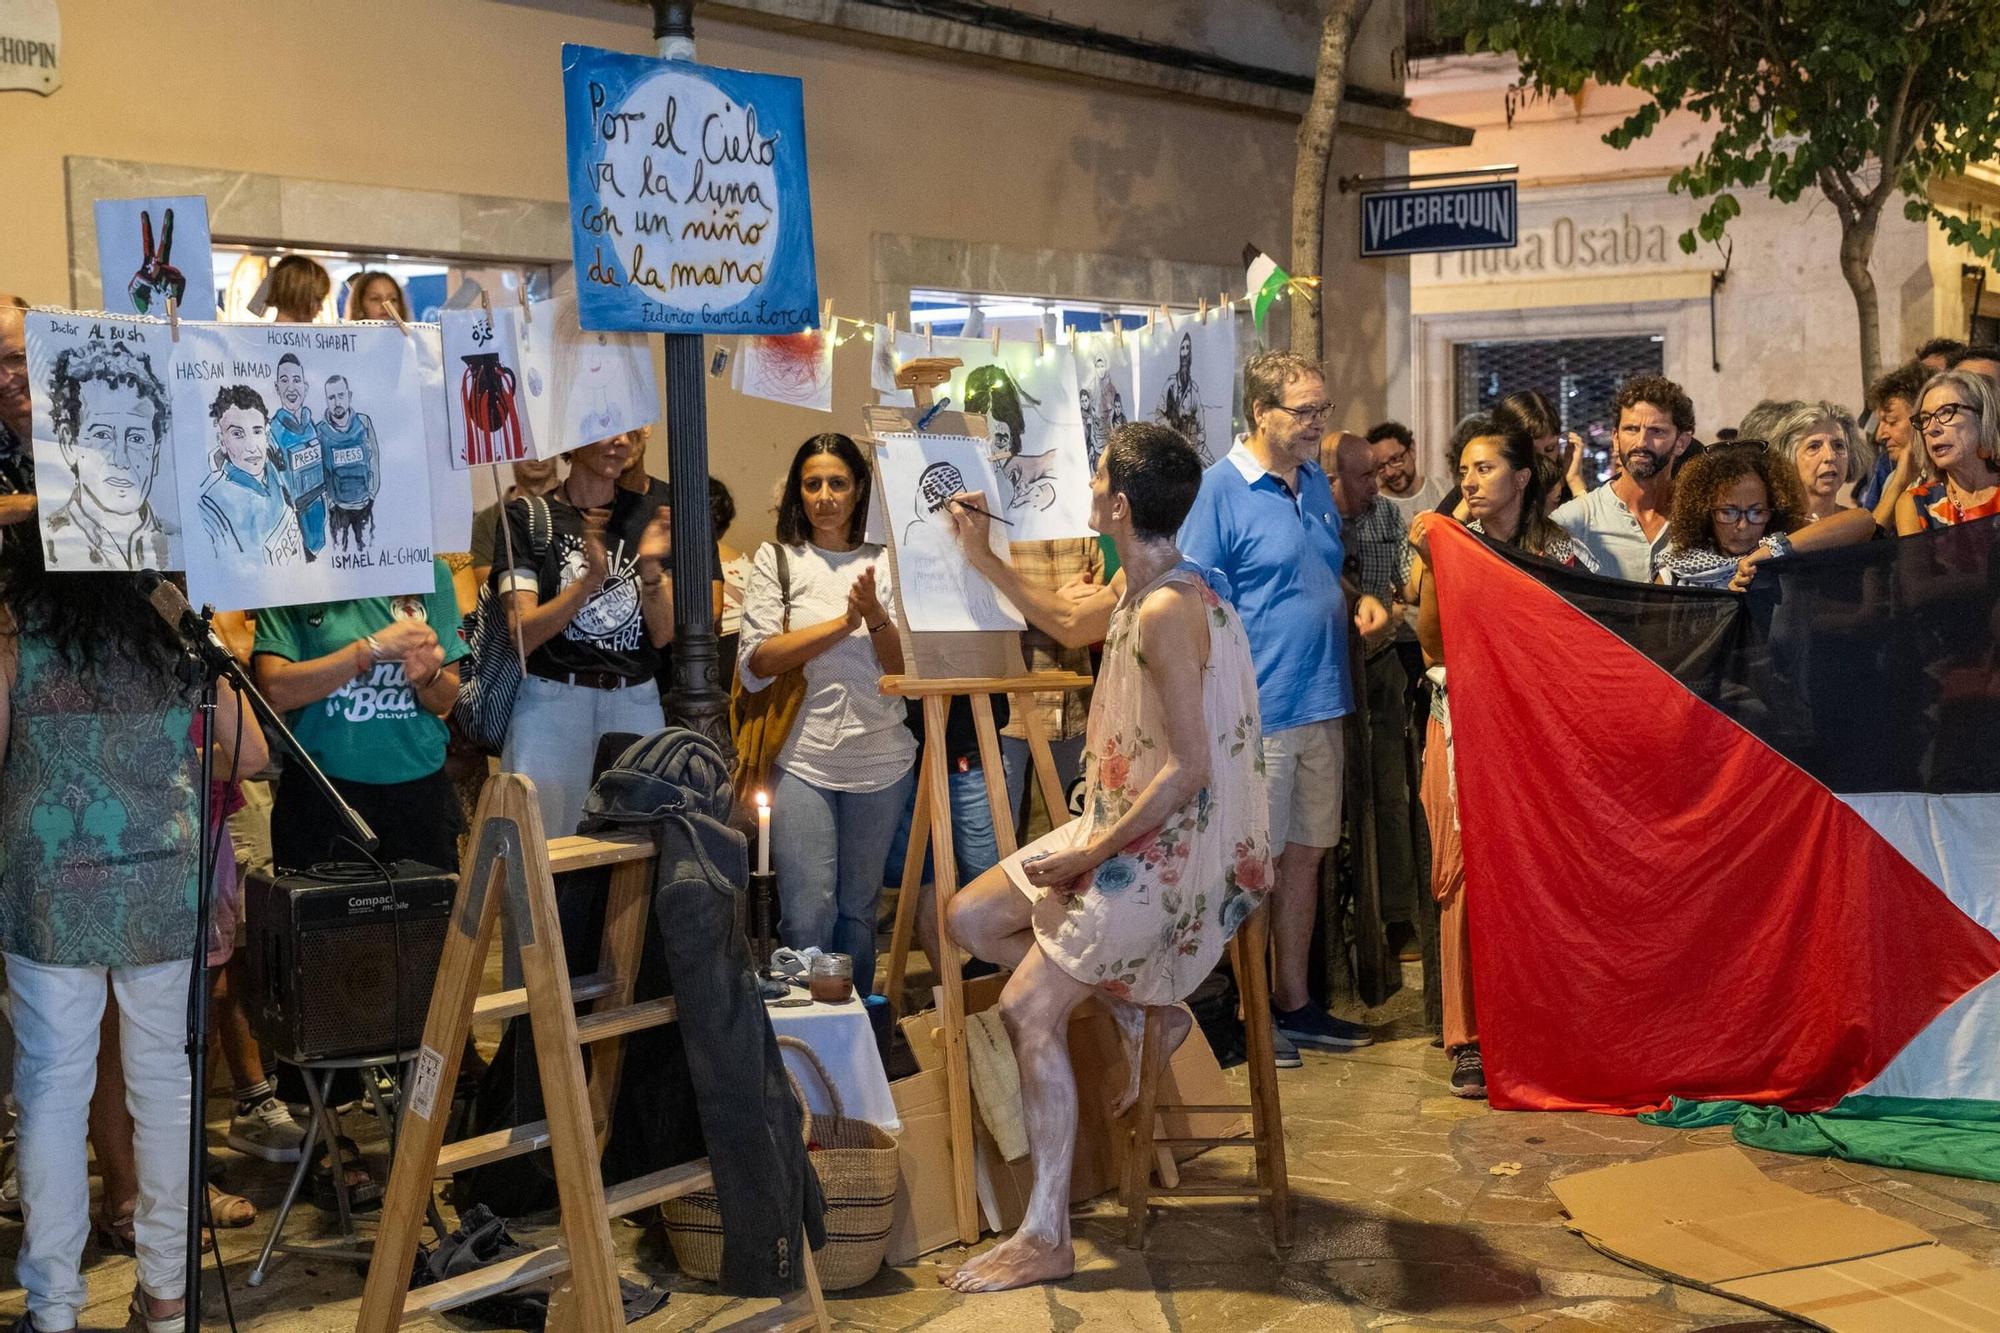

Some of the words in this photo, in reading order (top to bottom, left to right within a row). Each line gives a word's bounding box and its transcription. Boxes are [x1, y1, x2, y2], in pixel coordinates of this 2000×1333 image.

[0, 36, 56, 69] HOPIN
[588, 81, 646, 144] Por
[653, 95, 687, 155] el
[587, 162, 625, 198] va
[639, 156, 677, 203] la
[685, 159, 773, 212] luna
[634, 211, 673, 242] un
[682, 209, 770, 245] niño
[1368, 190, 1511, 249] VILEBREQUIN
[1553, 213, 1668, 269] Osaba
[587, 247, 622, 288] de
[629, 244, 668, 293] la
[670, 256, 766, 289] mano
[50, 320, 80, 336] Doctor
[88, 324, 105, 340] AL
[642, 303, 695, 324] Federico
[756, 302, 815, 325] Lorca
[267, 331, 311, 349] HOSSAM
[315, 333, 357, 352] SHABAT
[176, 361, 225, 380] HASSAN
[233, 361, 272, 379] HAMAD
[294, 448, 320, 467] PRESS
[333, 450, 363, 464] PRESS
[331, 554, 375, 570] ISMAEL
[379, 546, 434, 566] AL-GHOUL
[613, 615, 643, 652] FREE
[344, 687, 416, 722] Bac
